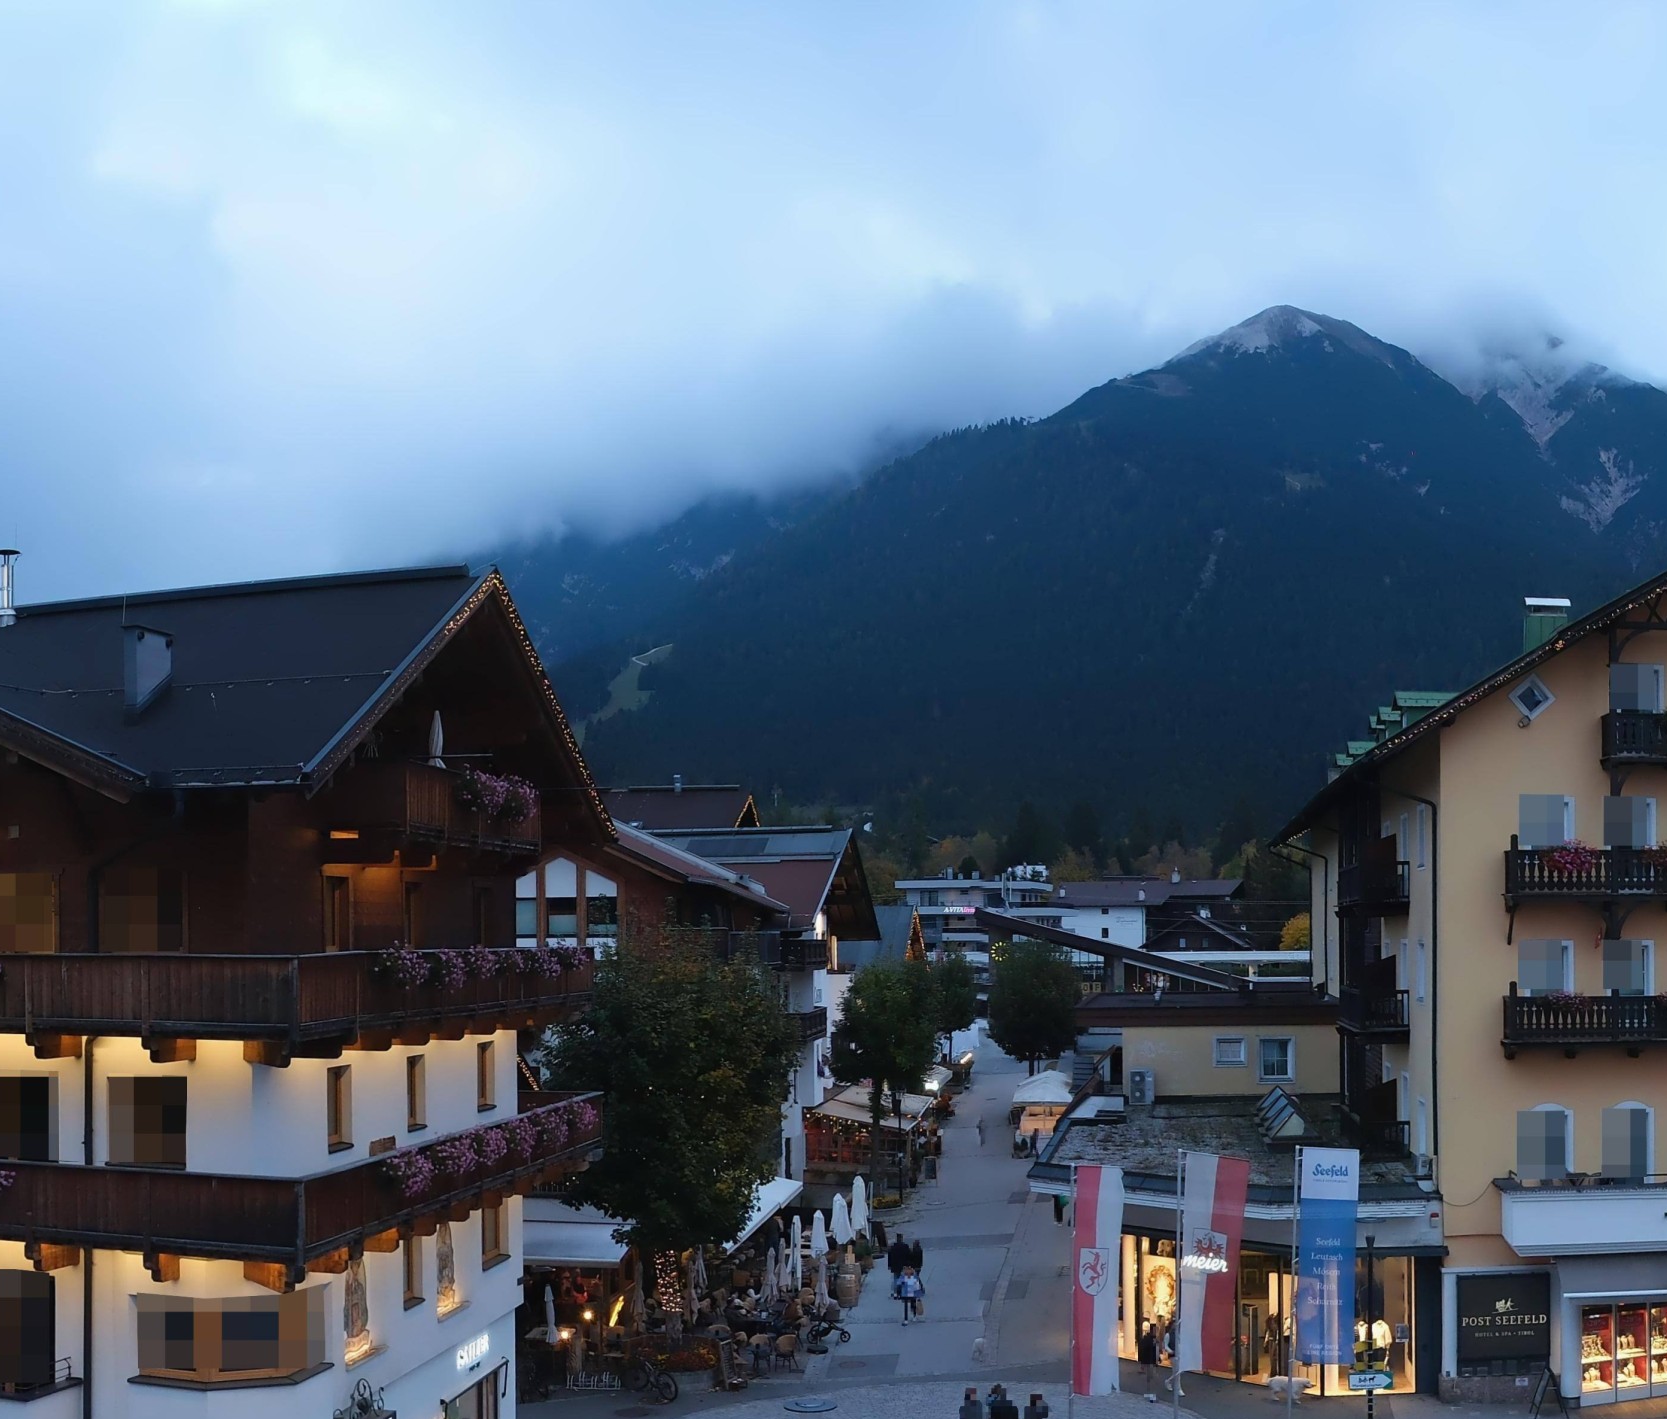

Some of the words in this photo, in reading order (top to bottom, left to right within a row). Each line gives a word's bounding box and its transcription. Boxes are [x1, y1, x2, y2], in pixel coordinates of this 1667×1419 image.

[1313, 1164, 1348, 1177] Seefeld
[1316, 1237, 1341, 1246] Seefeld
[1183, 1252, 1228, 1272] meier
[1311, 1252, 1343, 1261] Leutasch
[1462, 1317, 1491, 1327] POST
[1495, 1314, 1547, 1325] SEEFELD
